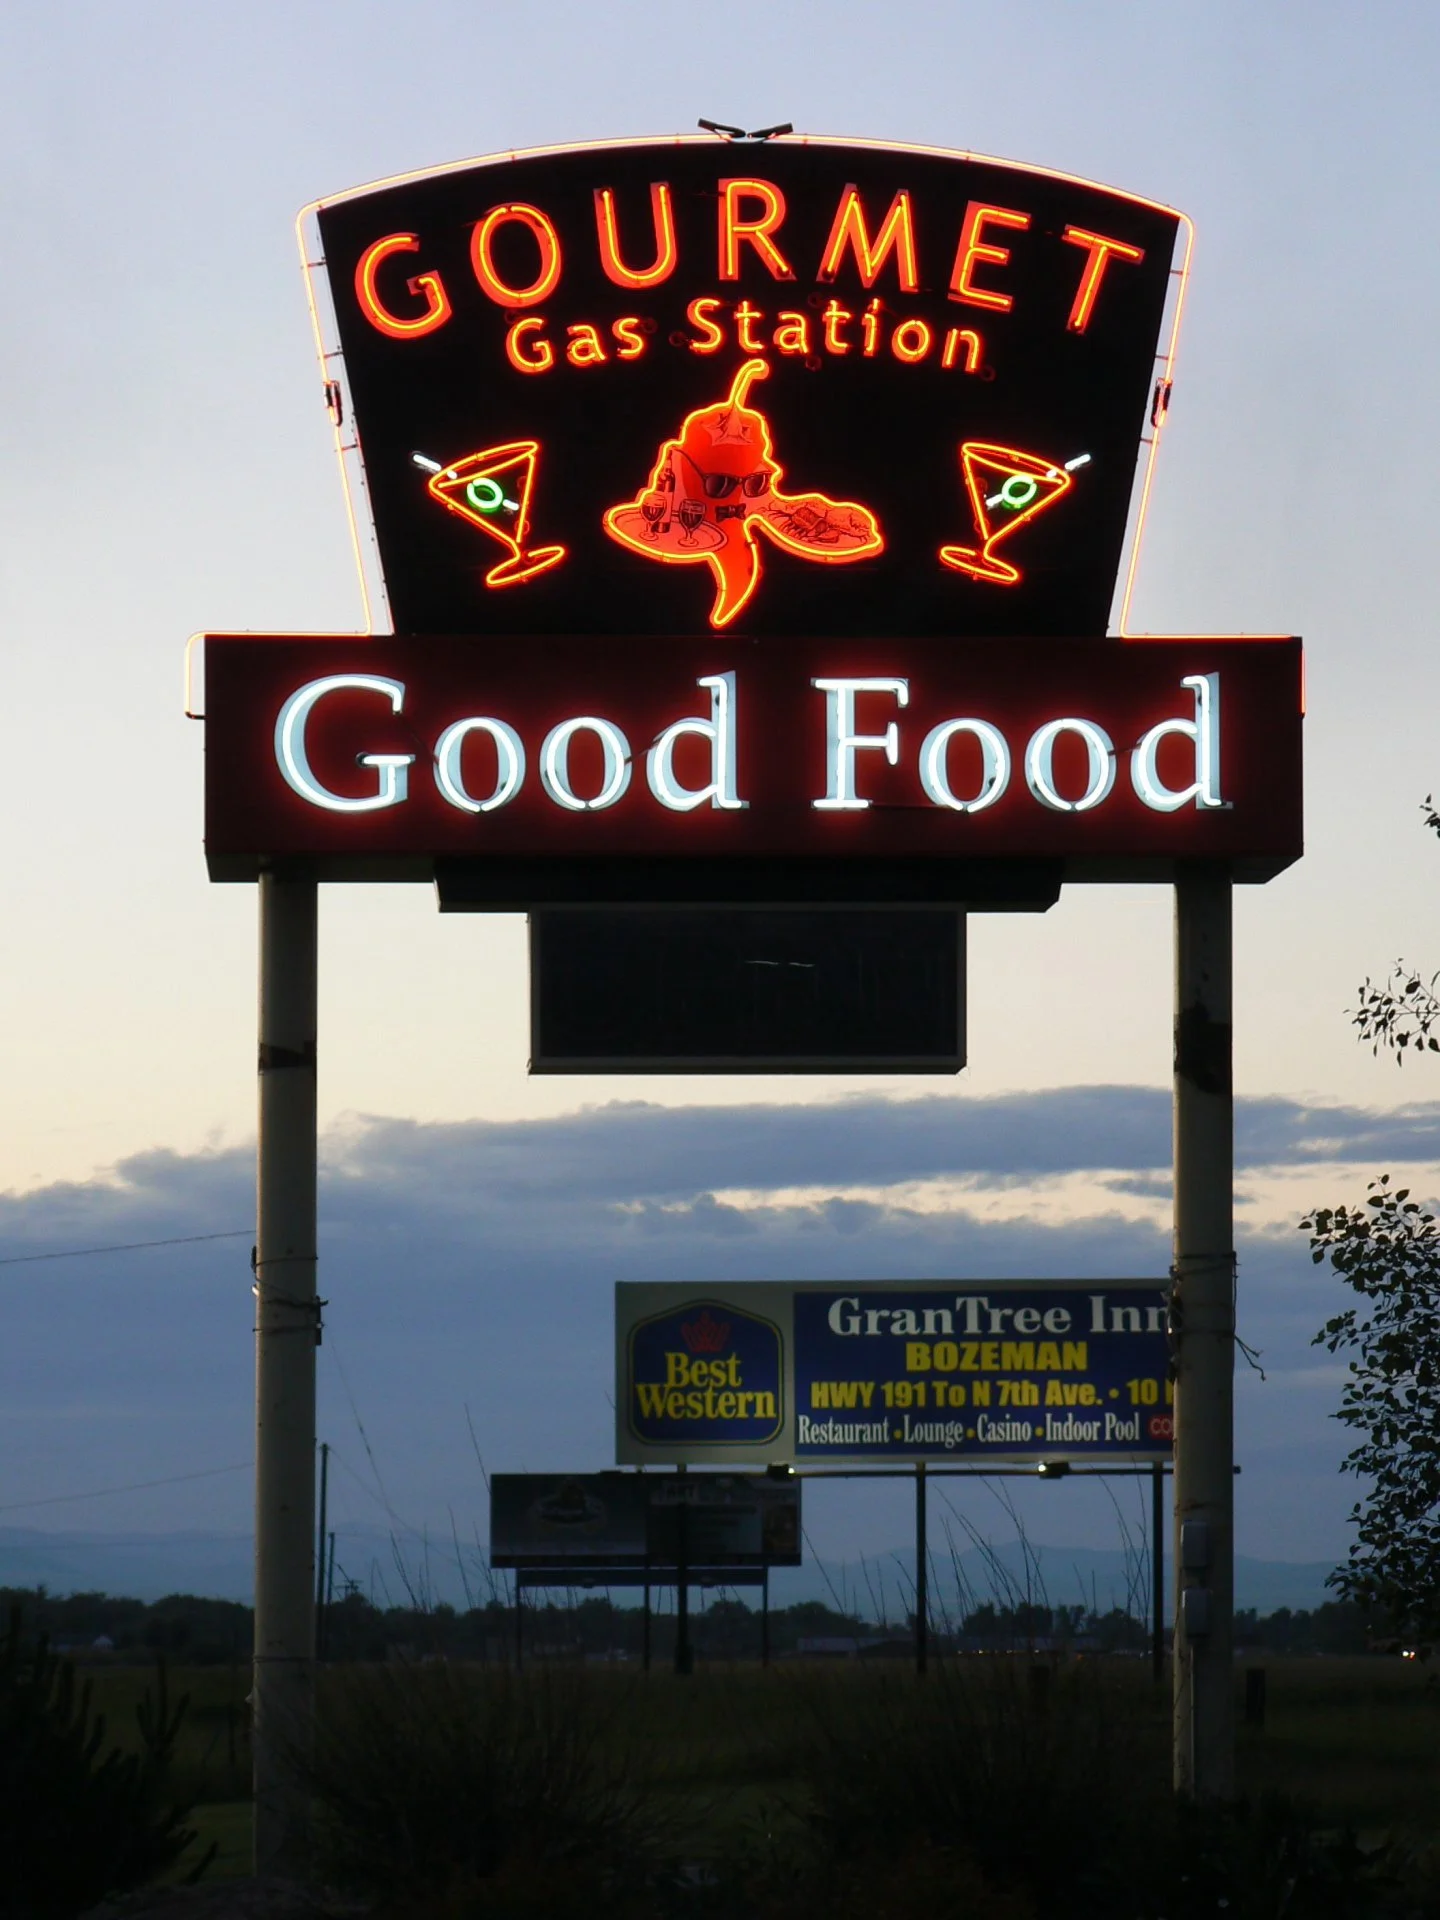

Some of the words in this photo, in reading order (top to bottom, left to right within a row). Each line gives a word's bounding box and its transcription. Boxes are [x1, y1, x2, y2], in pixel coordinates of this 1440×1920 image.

[355, 176, 1146, 340] GOURMET
[505, 313, 647, 375] Gas
[686, 297, 984, 374] Station
[273, 670, 749, 814] Good
[811, 672, 1233, 814] Food
[828, 1296, 1072, 1337] GranTree
[664, 1351, 742, 1388] Best
[905, 1341, 1089, 1373] BOZEMAN
[634, 1380, 778, 1420] Western
[810, 1380, 876, 1409] HWY
[881, 1380, 926, 1409] 191
[932, 1380, 966, 1408] To
[973, 1379, 991, 1408] N
[996, 1378, 1039, 1407] 7th
[1044, 1377, 1103, 1407] Ave.
[1126, 1377, 1158, 1406] 10
[797, 1414, 890, 1445] Restaurant
[903, 1414, 964, 1450] Lounge
[976, 1413, 1032, 1443] Casino
[1045, 1412, 1101, 1442] Indoor
[1104, 1412, 1141, 1441] Pool
